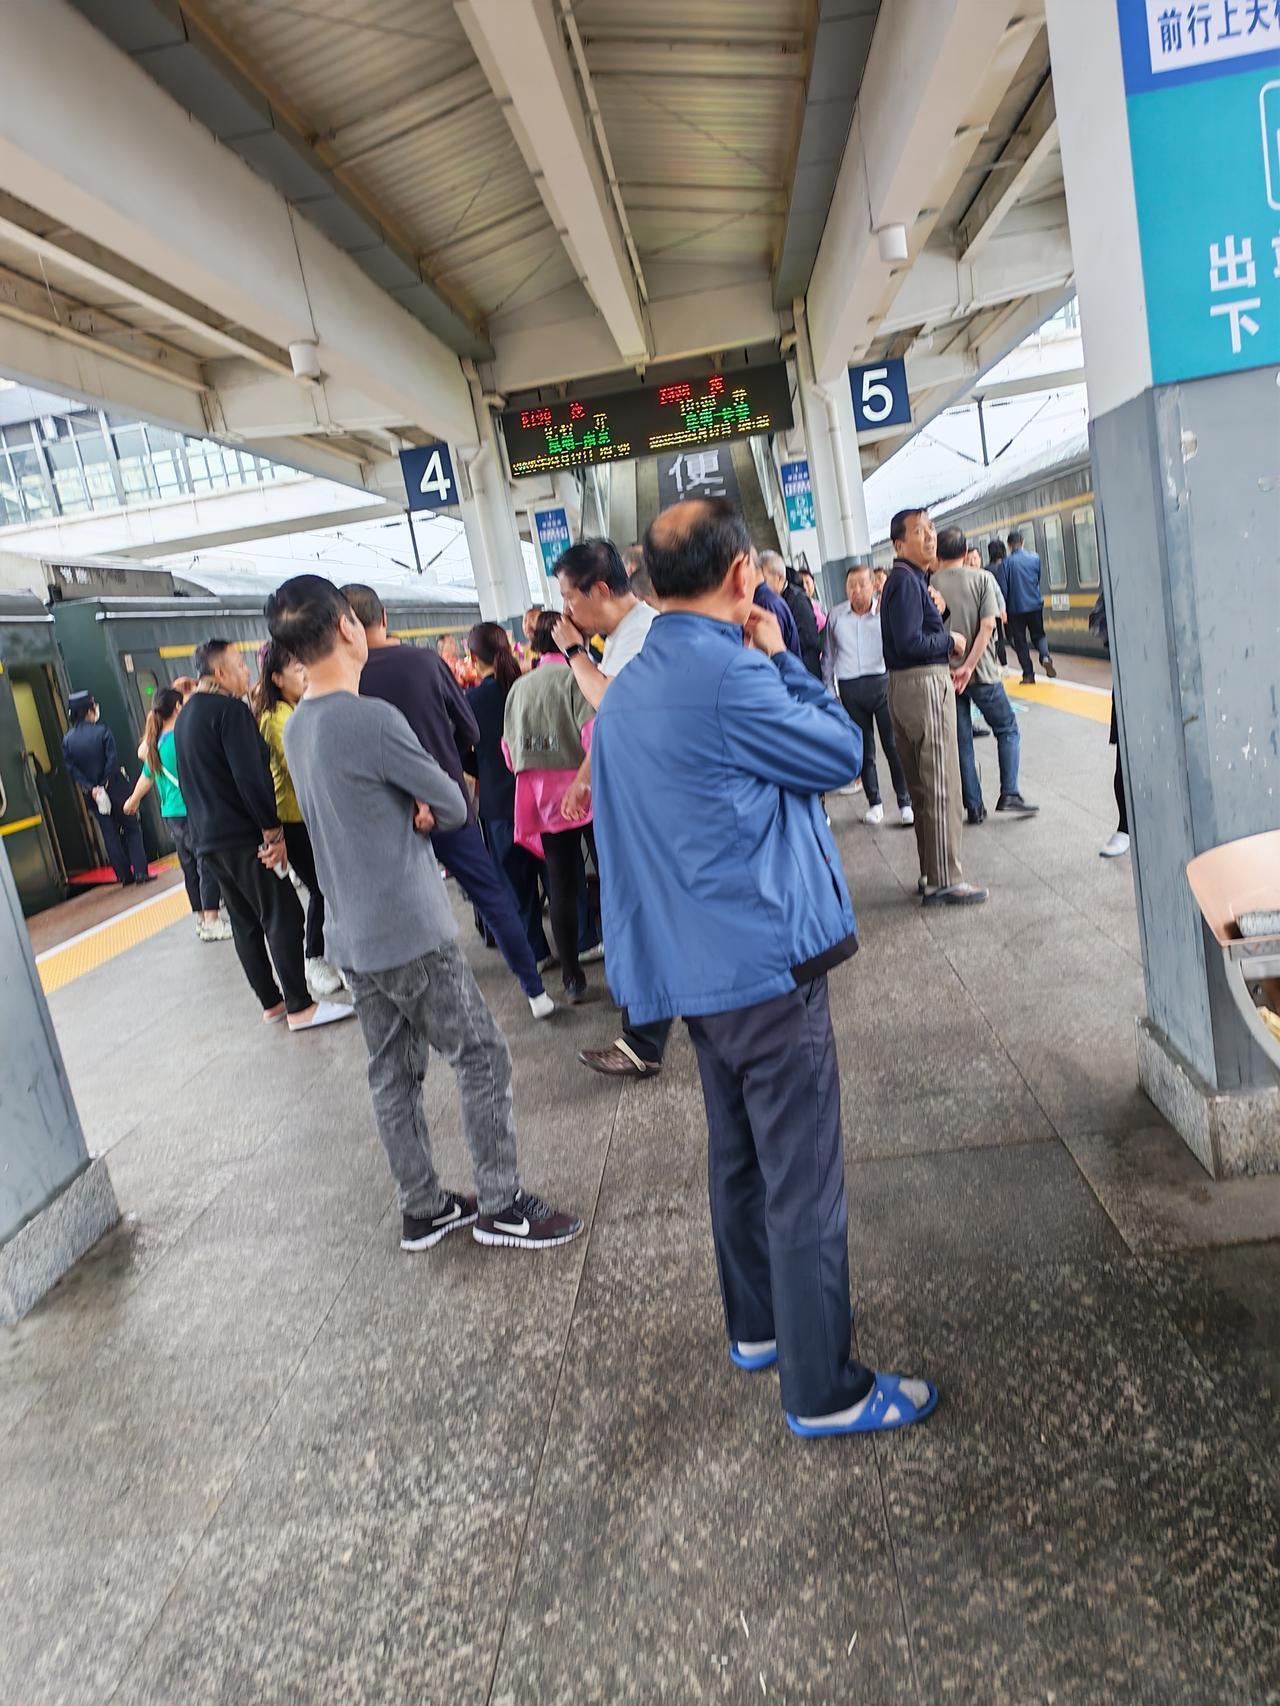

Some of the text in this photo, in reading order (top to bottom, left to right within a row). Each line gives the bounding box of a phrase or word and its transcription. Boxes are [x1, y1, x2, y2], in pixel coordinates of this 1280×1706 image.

[1158, 0, 1280, 53] 前行上天
[1209, 233, 1280, 292] 出
[861, 367, 894, 422] 5
[420, 450, 451, 501] 4
